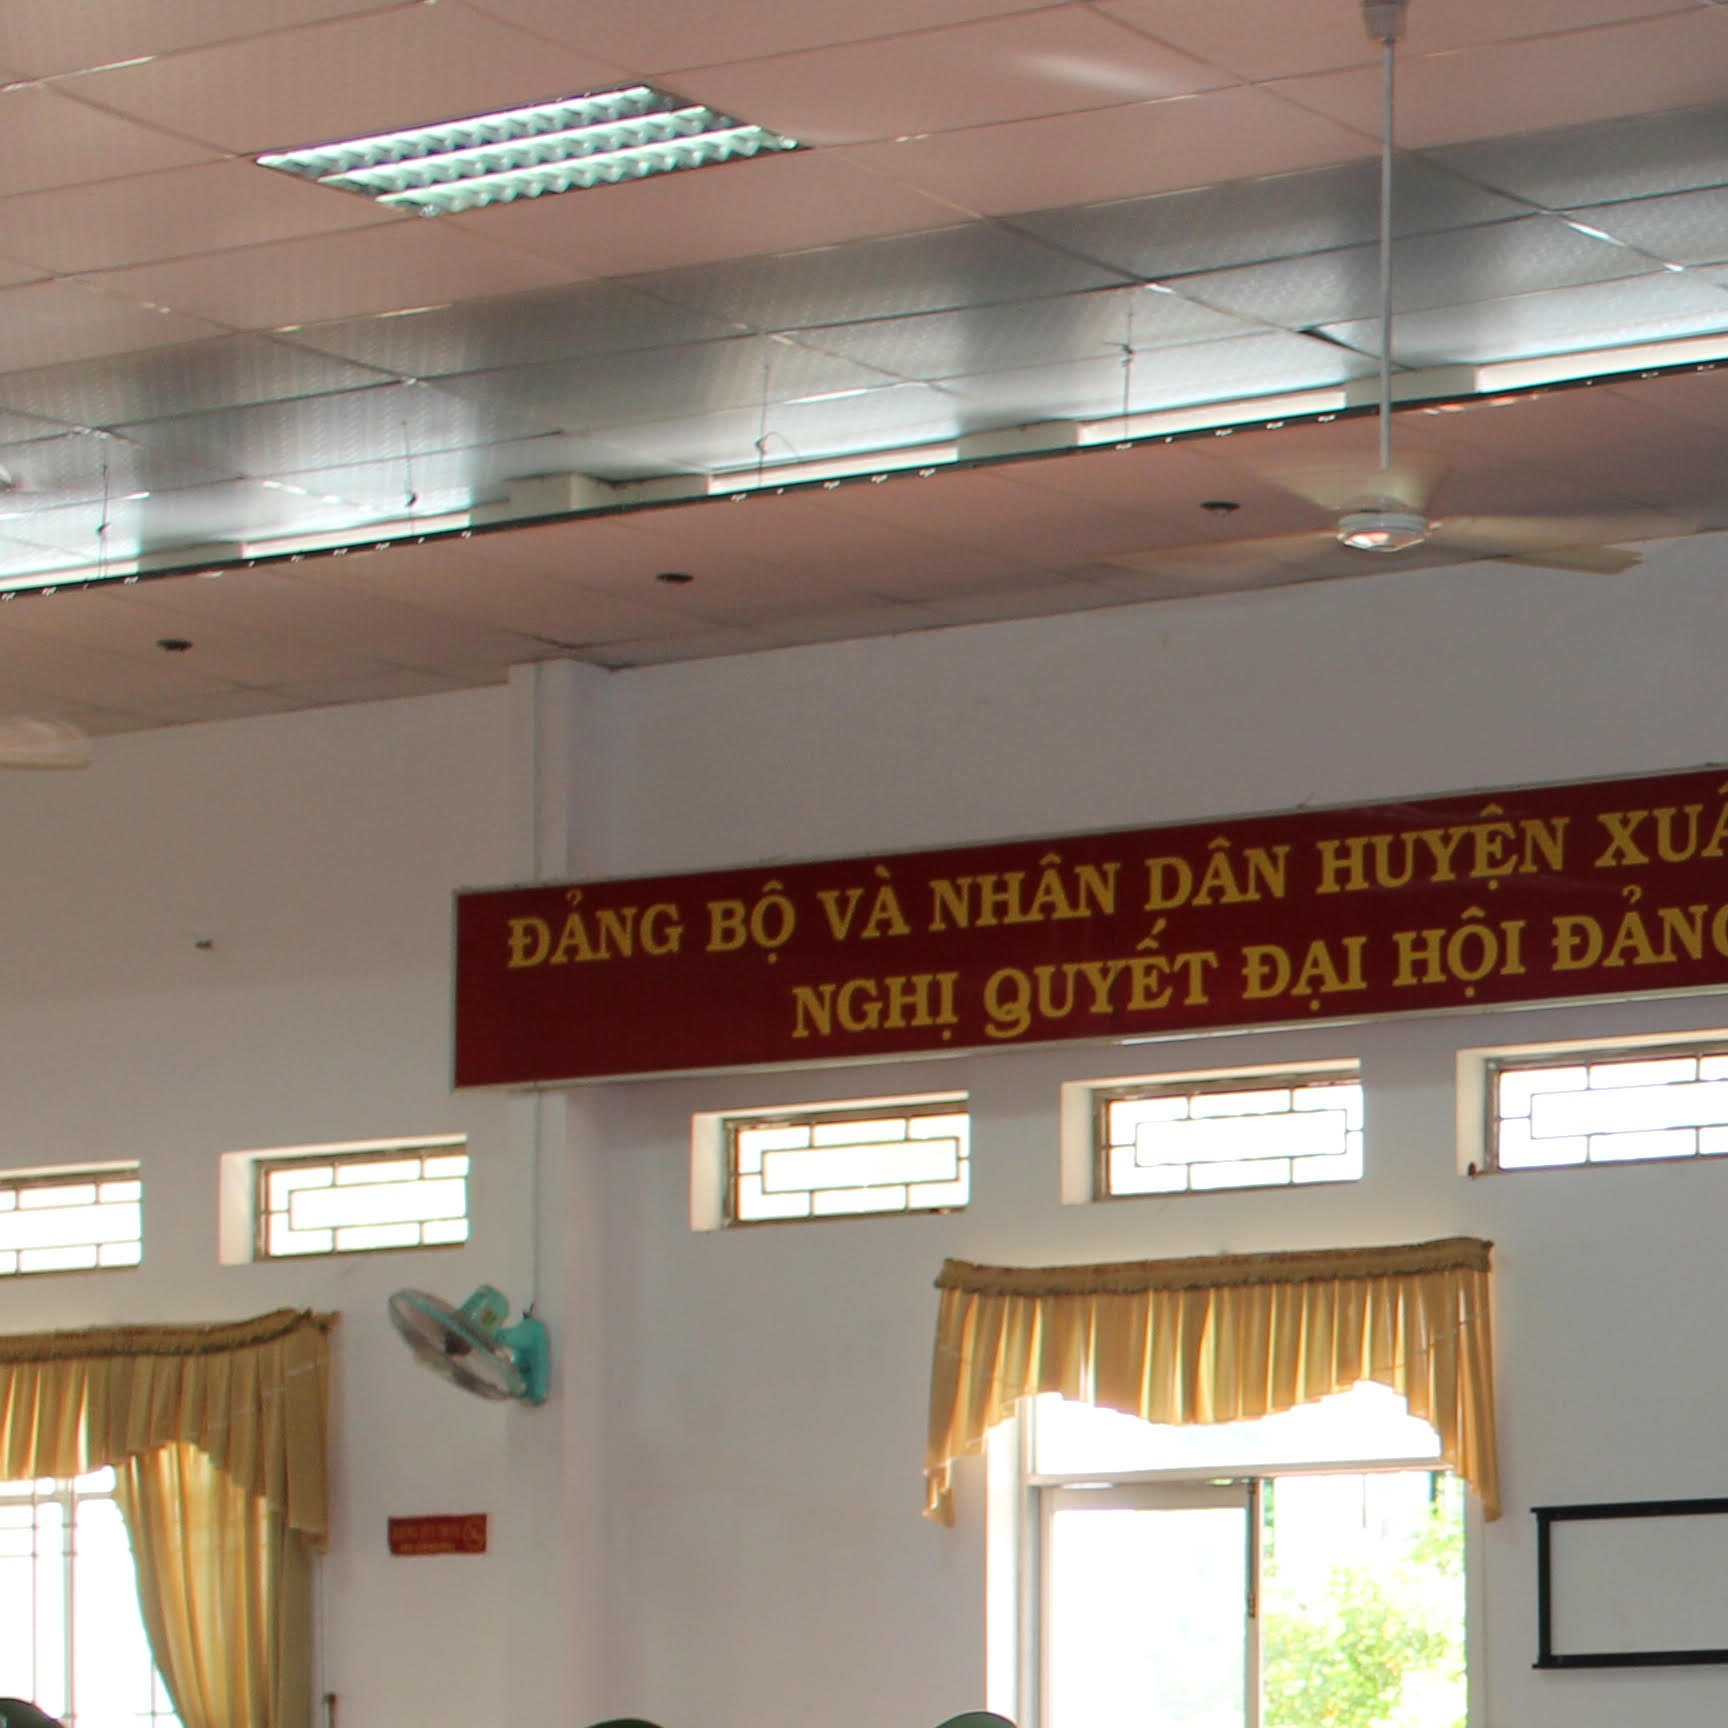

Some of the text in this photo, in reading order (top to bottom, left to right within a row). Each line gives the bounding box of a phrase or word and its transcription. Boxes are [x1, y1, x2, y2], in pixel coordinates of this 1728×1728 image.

[507, 888, 684, 969] ĐẢNG
[705, 880, 797, 964] BỘ
[816, 865, 912, 941] VÀ
[928, 852, 1122, 932] NHÂN
[1143, 836, 1292, 912] DÂN
[1315, 803, 1571, 895] HUYỆN
[791, 970, 960, 1042] NGHỊ
[982, 917, 1220, 1038] QUYẾT
[1240, 934, 1369, 1012] ĐẠI
[1391, 905, 1527, 998] HỘI
